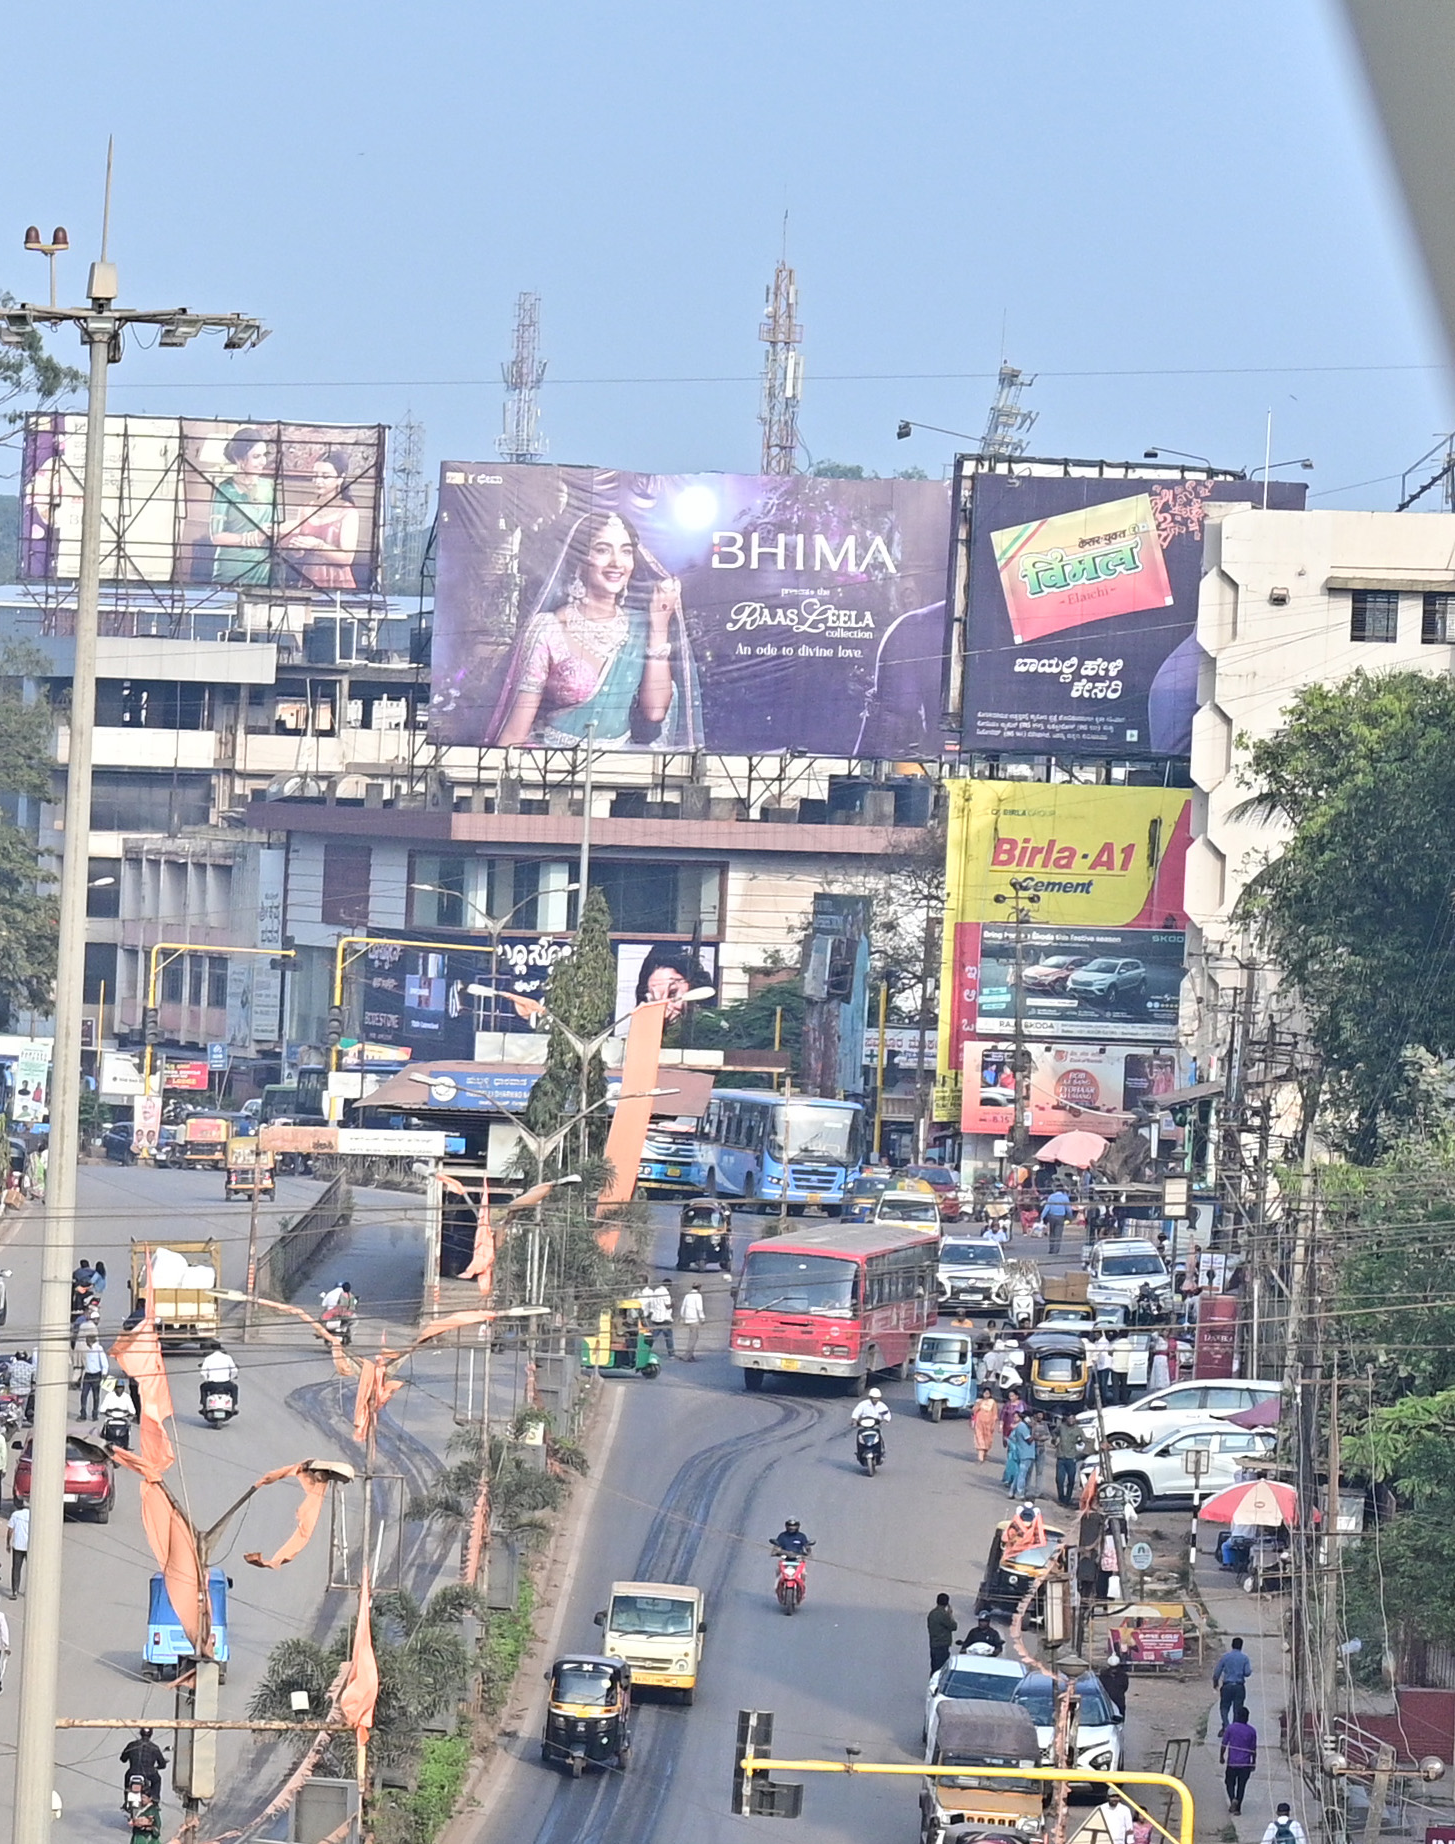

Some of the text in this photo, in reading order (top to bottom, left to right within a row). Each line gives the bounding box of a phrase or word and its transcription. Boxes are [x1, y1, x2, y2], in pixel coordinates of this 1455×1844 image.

[712, 531, 897, 573] BHIMA
[1067, 587, 1110, 606] Elaichi
[825, 628, 874, 639] collection
[735, 644, 753, 655] An
[756, 643, 778, 656] ode
[781, 644, 794, 656] to
[798, 643, 833, 657] divine
[1014, 656, 1124, 683] ಬಾಯಲ್ಲಿ ಹೇಳಿ
[1070, 679, 1122, 700] ಕೇಸರಿ
[990, 836, 1077, 870] Birla
[1020, 876, 1094, 895] Cement
